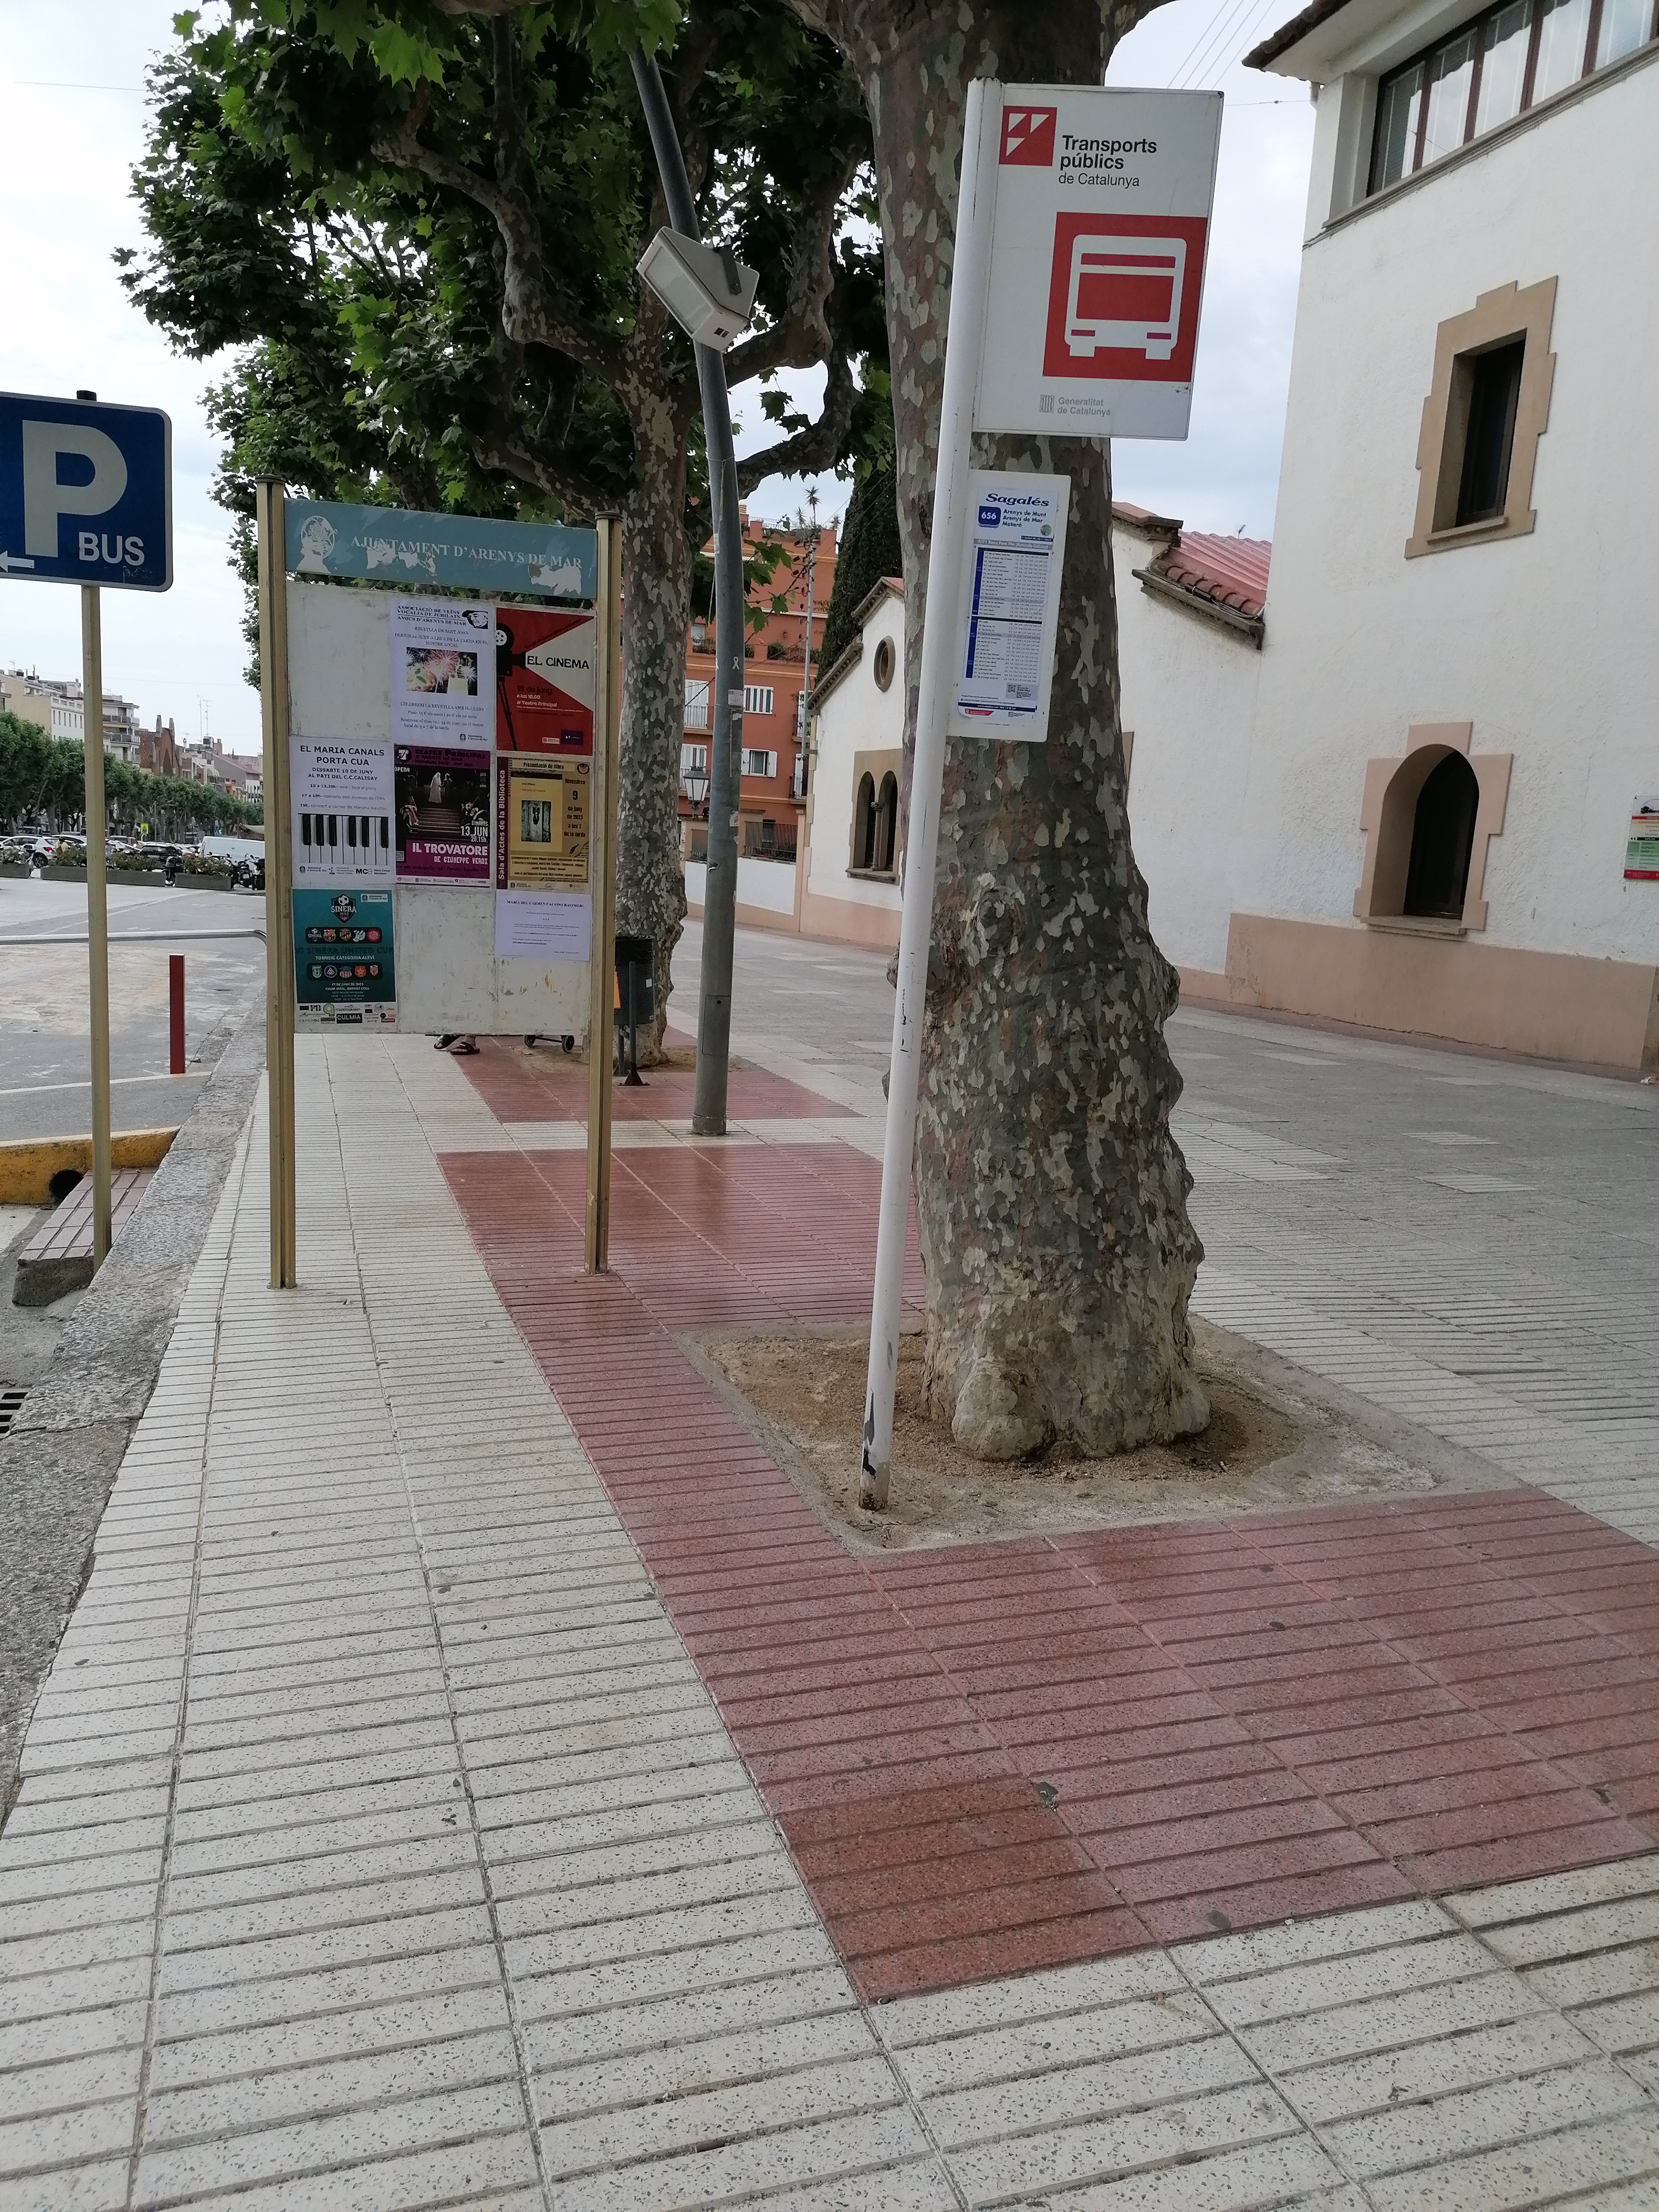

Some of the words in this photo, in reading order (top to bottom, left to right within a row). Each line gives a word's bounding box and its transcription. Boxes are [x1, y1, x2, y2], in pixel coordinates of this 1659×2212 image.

[1062, 134, 1157, 155] Transports
[1060, 153, 1124, 170] públics
[1058, 173, 1074, 184] de
[1078, 173, 1140, 189] Catalunya
[1058, 397, 1103, 406] Generalitat
[1070, 407, 1111, 417] Catalunya
[22, 420, 127, 557] P
[985, 493, 1050, 507] Sagalés
[981, 511, 997, 519] 656
[79, 531, 145, 566] BUS
[351, 535, 450, 556] AJUNTAMENT
[453, 545, 525, 564] D'ARENYS
[528, 554, 546, 564] DE
[550, 555, 582, 568] MAR
[528, 655, 542, 665] EL
[546, 657, 589, 669] CINEMA
[314, 746, 345, 754] MARIA
[348, 748, 384, 756] CANALS
[316, 757, 348, 765] PORTA
[572, 790, 578, 800] 9
[499, 820, 505, 830] de
[412, 843, 422, 853] IL
[424, 843, 488, 856] TROVATORE
